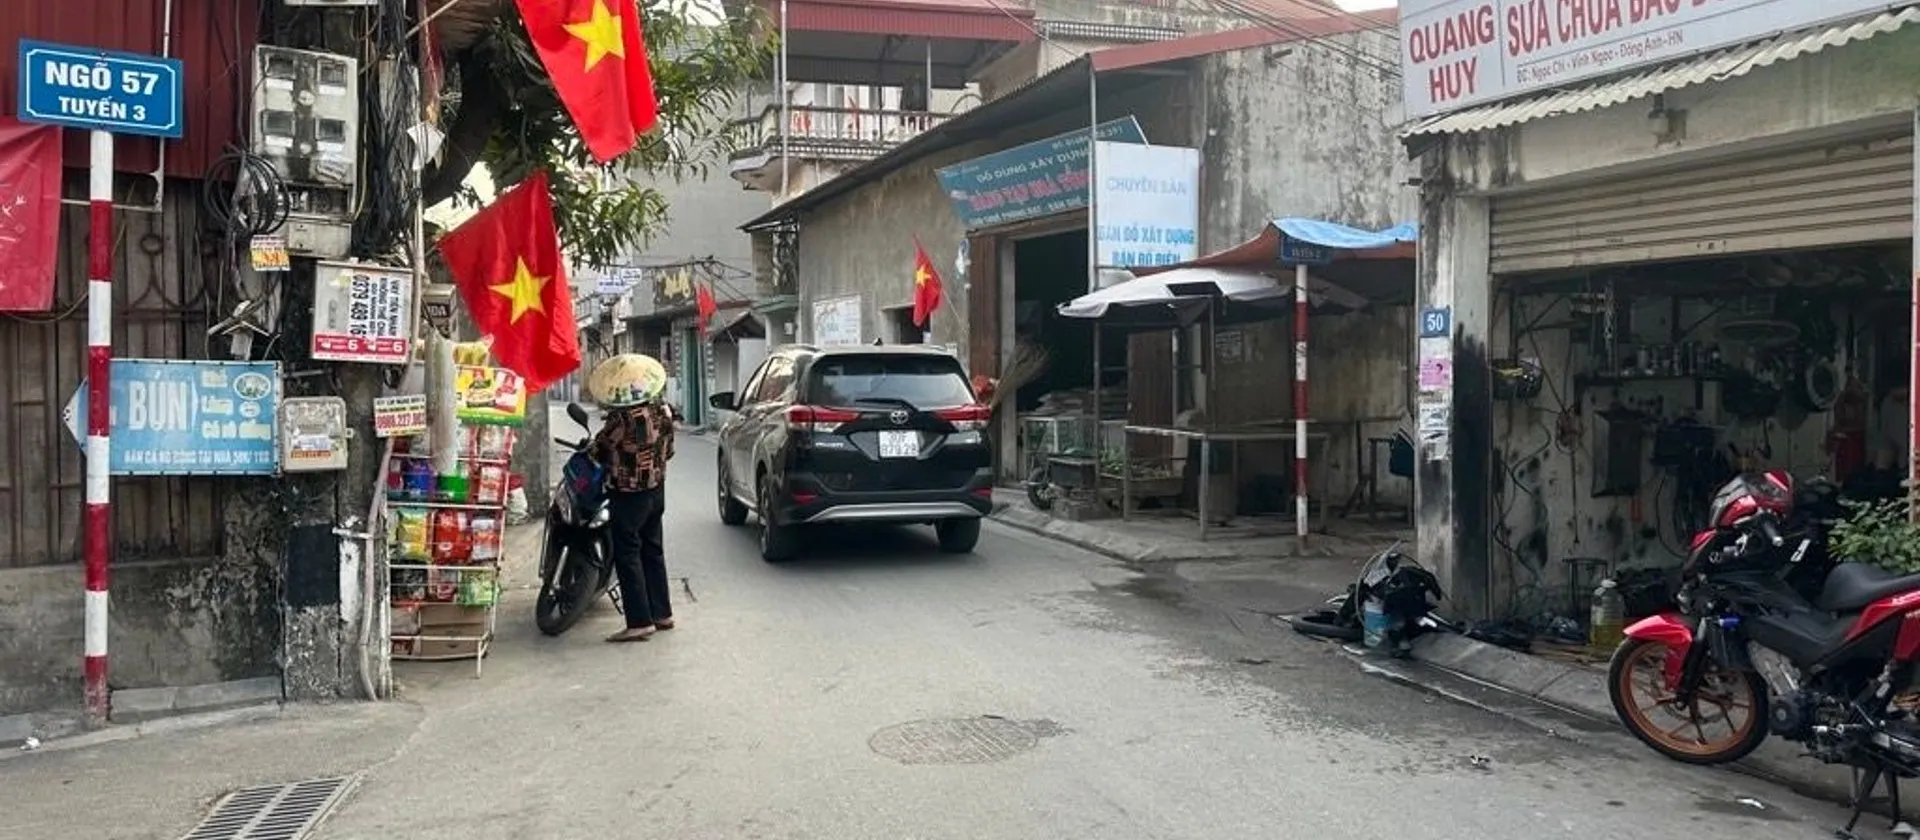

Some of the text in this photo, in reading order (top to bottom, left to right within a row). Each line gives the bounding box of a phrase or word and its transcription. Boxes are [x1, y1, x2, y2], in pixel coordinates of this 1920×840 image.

[1409, 5, 1495, 64] QUANG
[45, 61, 159, 96] NGÕ 57
[1429, 56, 1477, 103] HUY
[58, 95, 146, 121] TUYẾN 3
[1426, 313, 1444, 331] 50
[128, 371, 188, 432] BÚN
